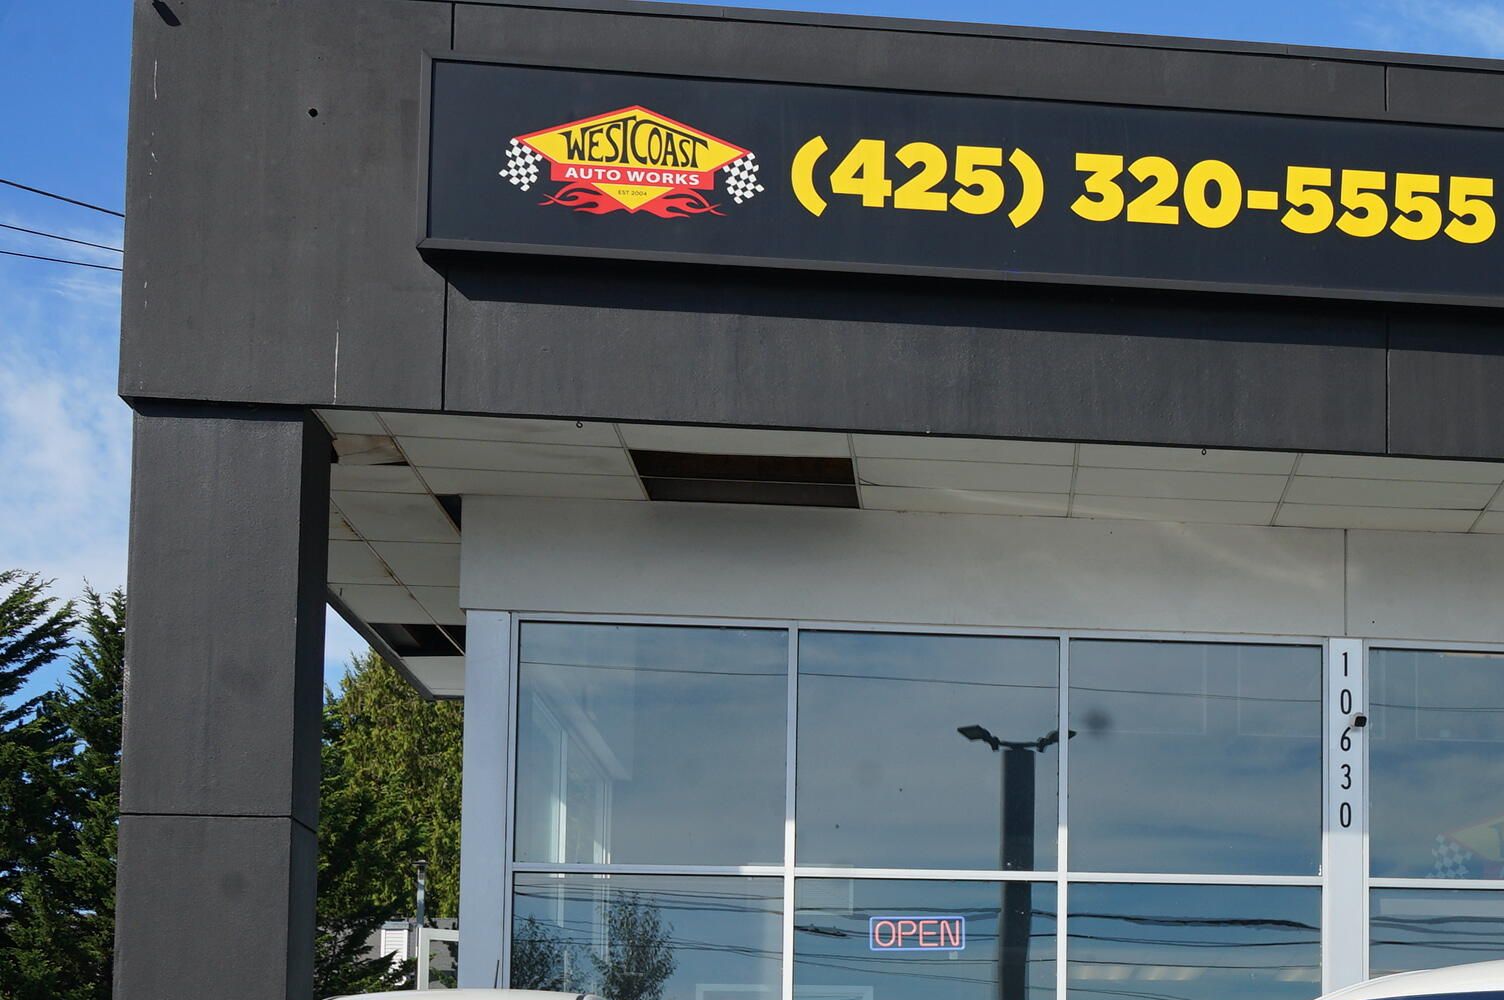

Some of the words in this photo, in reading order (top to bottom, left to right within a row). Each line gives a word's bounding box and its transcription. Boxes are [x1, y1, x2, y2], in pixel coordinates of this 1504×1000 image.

[565, 167, 621, 181] AUTO
[627, 171, 700, 186] WORKS
[791, 136, 1044, 229] (425)
[1072, 153, 1496, 244] 320-5555
[1339, 651, 1352, 829] 10630
[874, 919, 960, 948] OPEN
